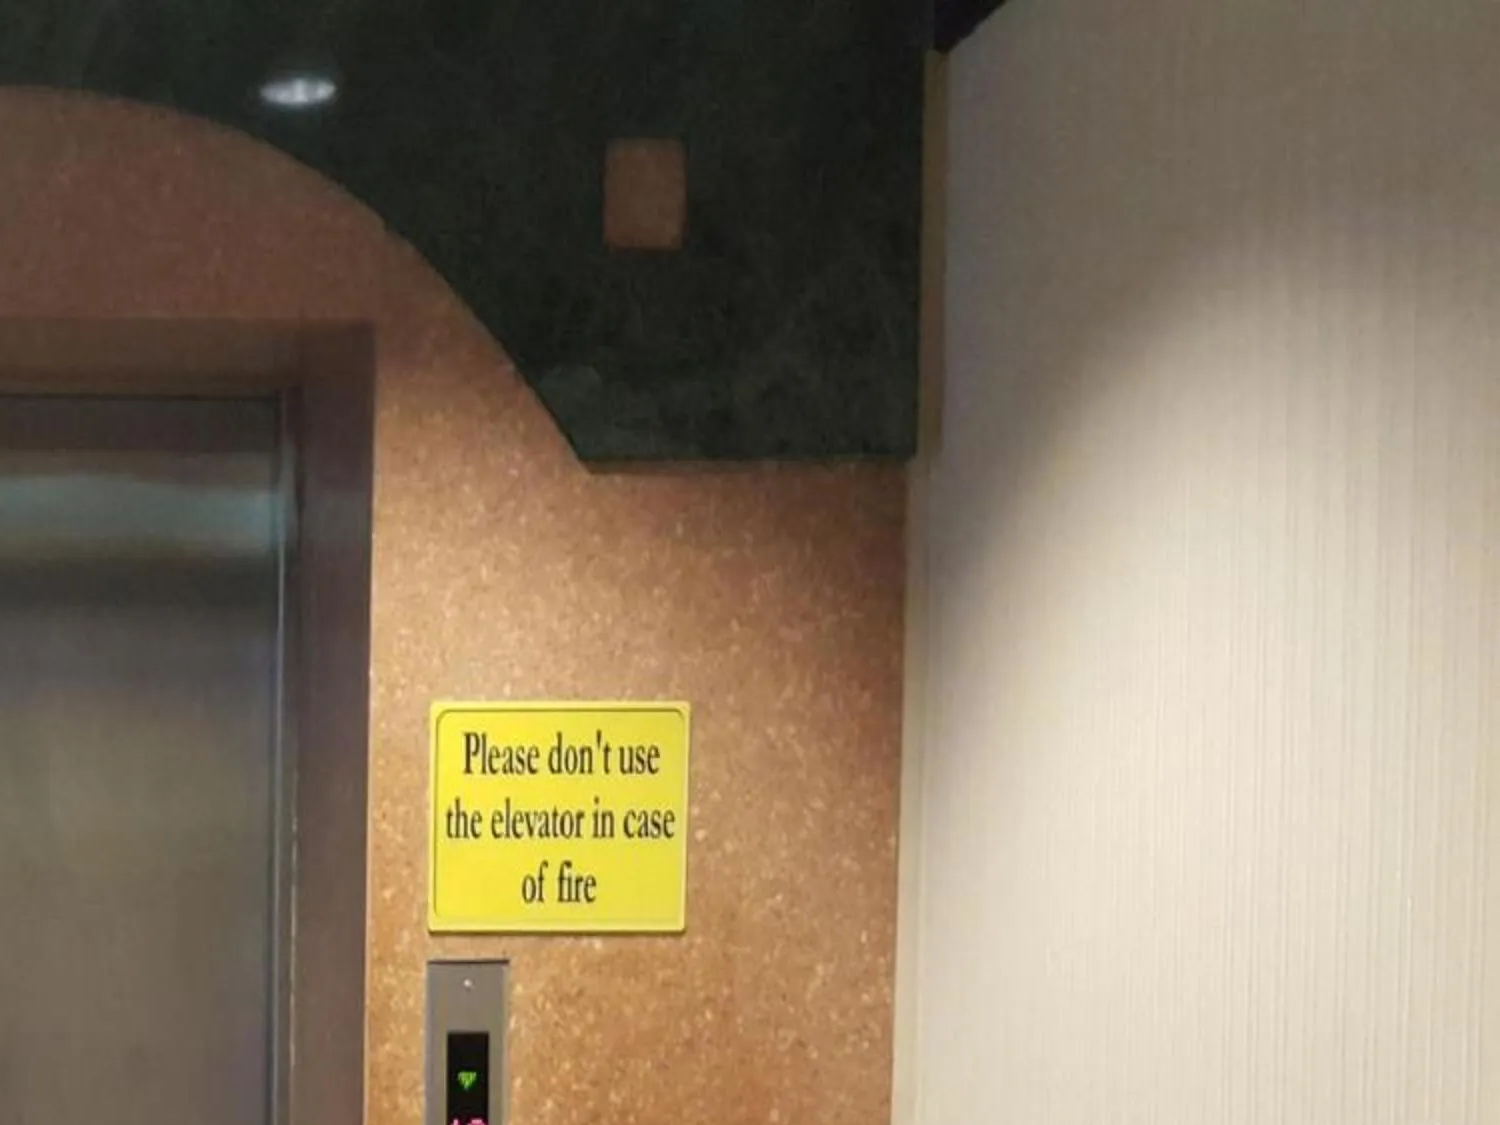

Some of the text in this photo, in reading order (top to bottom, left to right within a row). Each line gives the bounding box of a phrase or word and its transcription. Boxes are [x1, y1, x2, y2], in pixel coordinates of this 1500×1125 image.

[463, 729, 661, 775] Please don't use
[446, 795, 676, 839] the elevator in case
[521, 859, 597, 904] of fire
